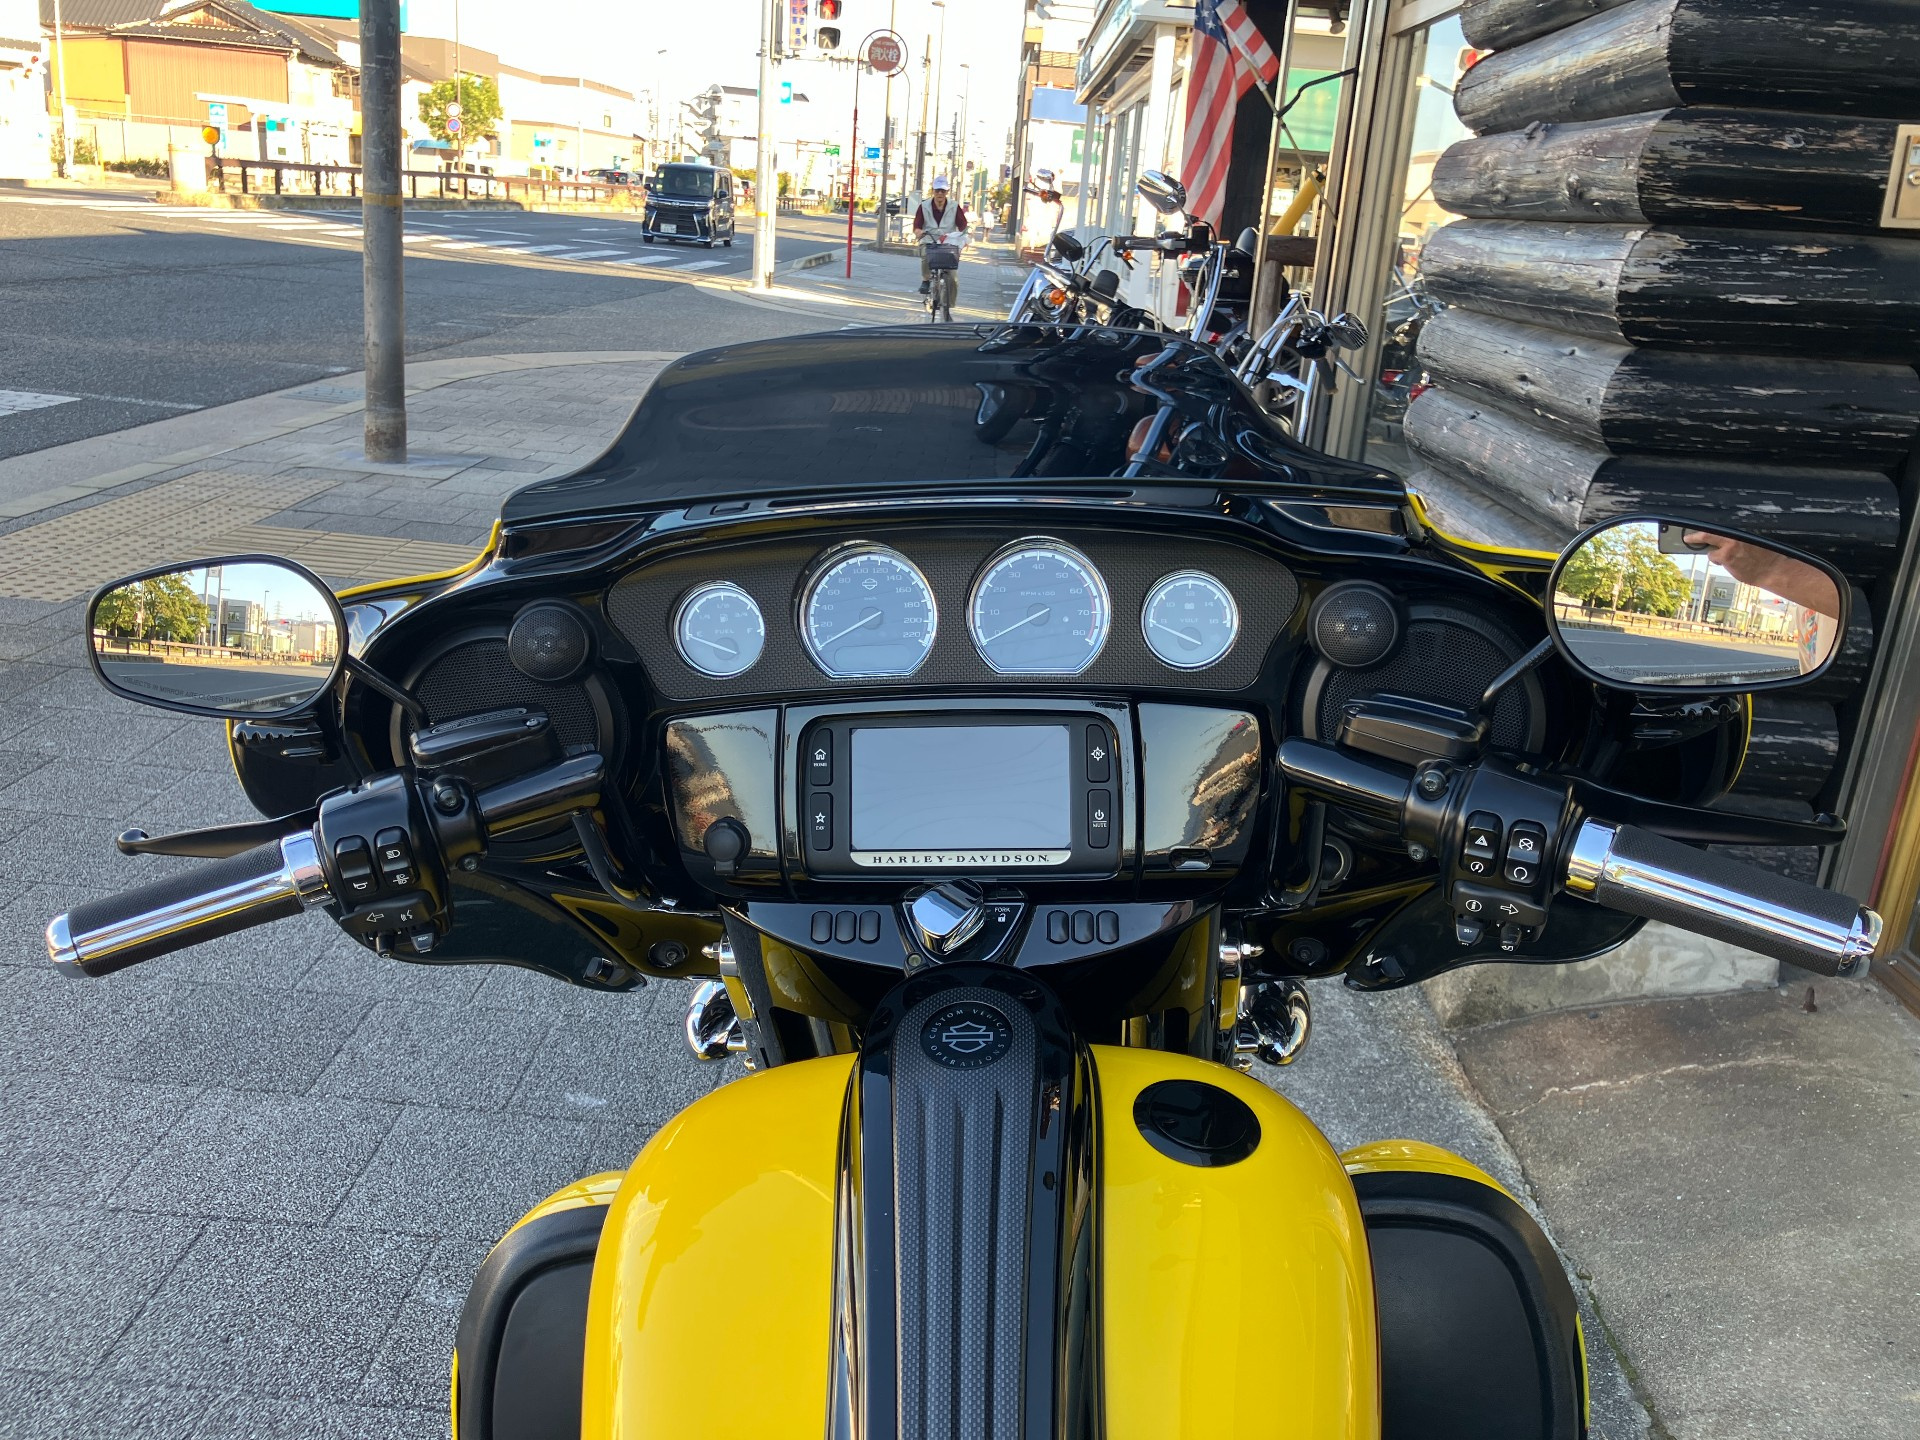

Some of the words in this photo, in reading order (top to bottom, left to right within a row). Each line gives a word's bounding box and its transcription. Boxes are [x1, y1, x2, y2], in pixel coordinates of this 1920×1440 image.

[871, 46, 899, 62] 消火栓
[1609, 665, 1640, 676] OBJECTS
[123, 676, 151, 688] OBJECTS
[160, 686, 184, 696] MIRROR
[199, 693, 223, 702] CLOSER
[929, 1009, 964, 1039] CUSTOM
[972, 1009, 1006, 1037] VEHICLE
[930, 1044, 1005, 1067] OPERATIONS
